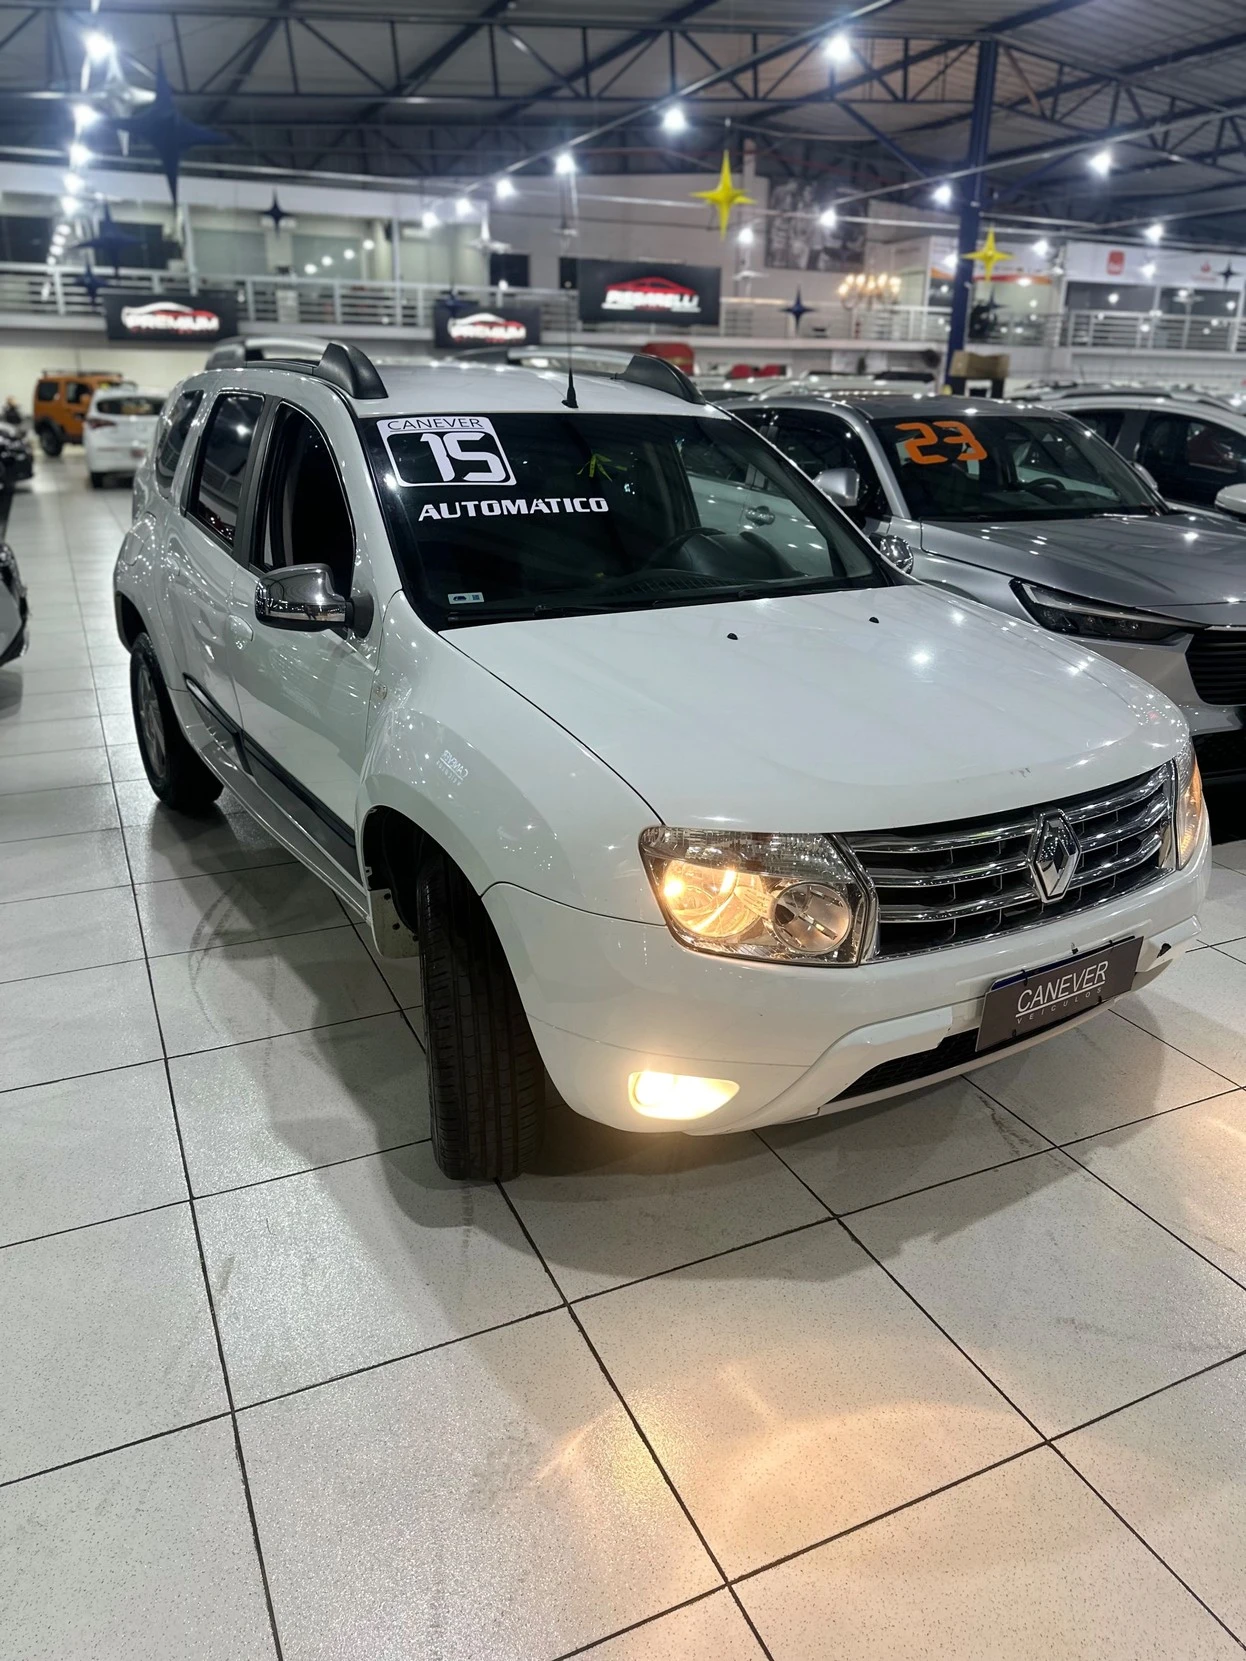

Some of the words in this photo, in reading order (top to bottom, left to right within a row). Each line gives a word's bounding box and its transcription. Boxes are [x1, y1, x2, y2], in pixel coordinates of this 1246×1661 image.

[387, 417, 484, 431] CANEVER
[895, 421, 988, 465] 23
[420, 432, 507, 482] 15
[1017, 987, 1102, 1025] VEICULOS
[1018, 960, 1109, 1013] CANEVER
